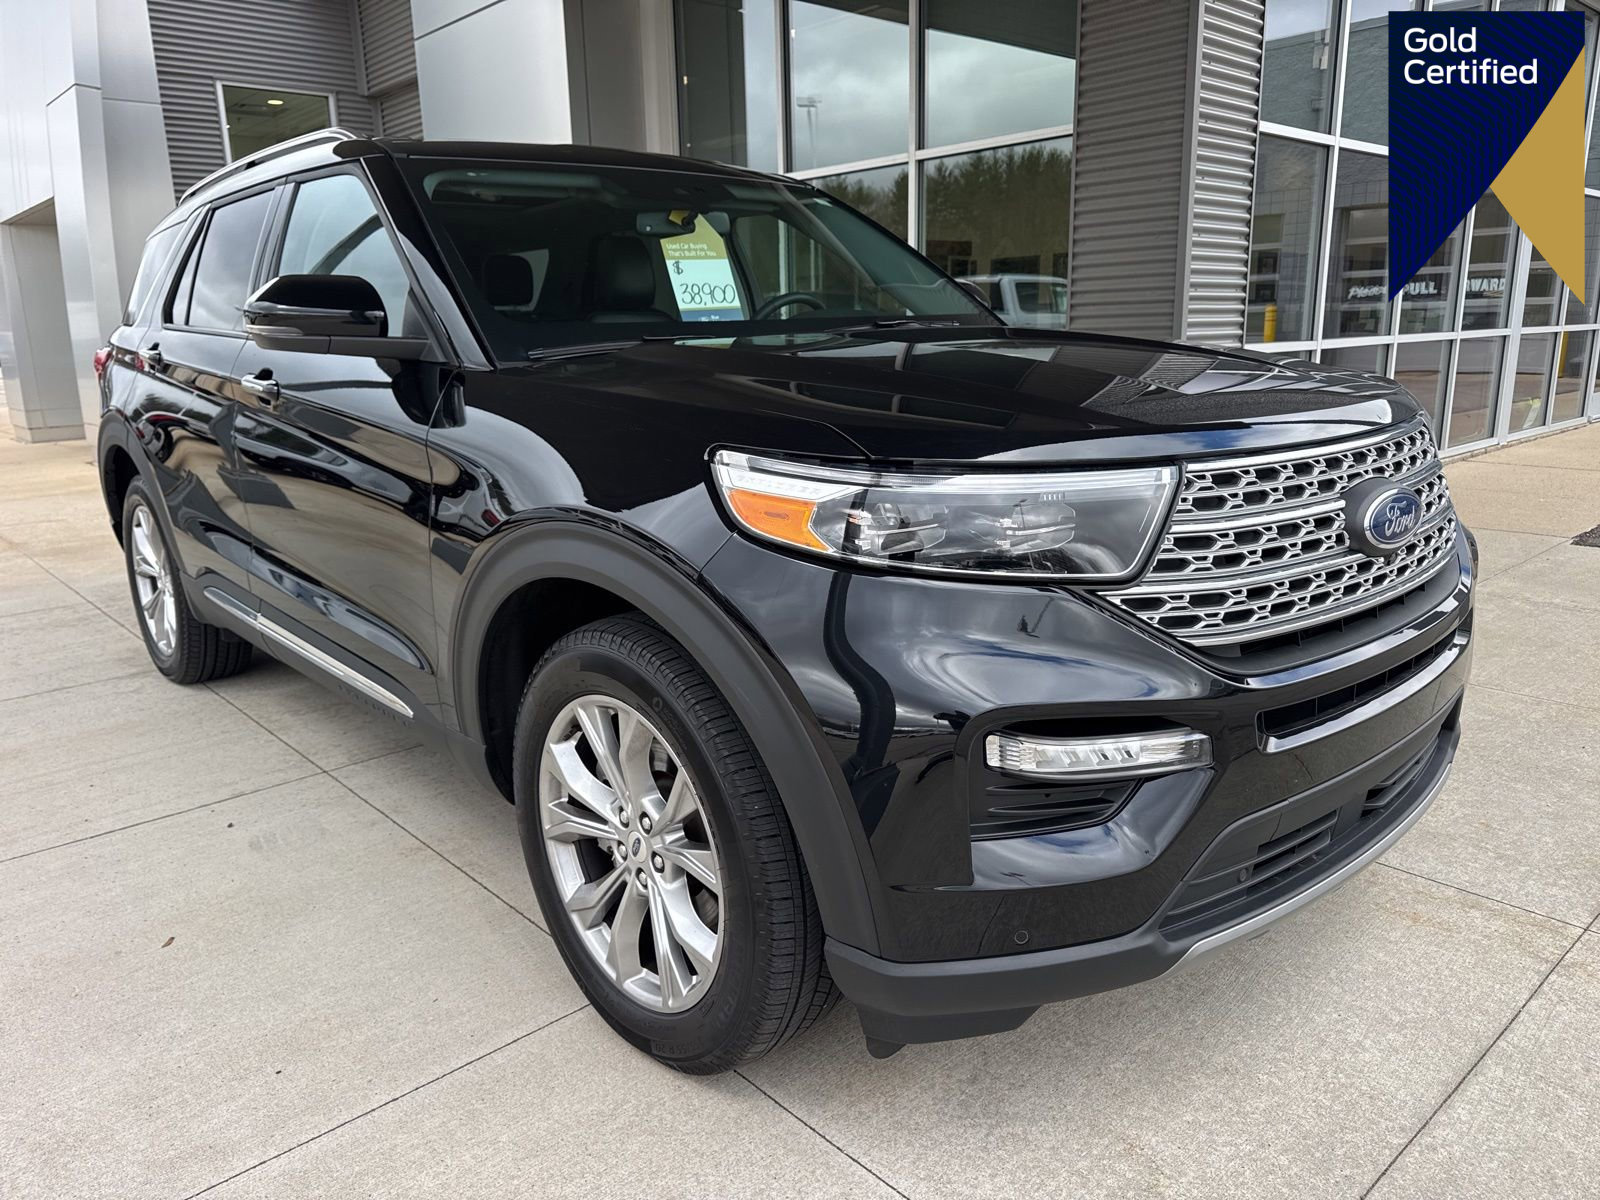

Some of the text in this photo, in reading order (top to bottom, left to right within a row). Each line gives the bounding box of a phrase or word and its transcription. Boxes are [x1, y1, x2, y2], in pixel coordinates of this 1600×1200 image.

[689, 243, 707, 251] Buying
[672, 260, 684, 275] $
[680, 282, 736, 306] 38,900
[1384, 500, 1417, 537] Ford
